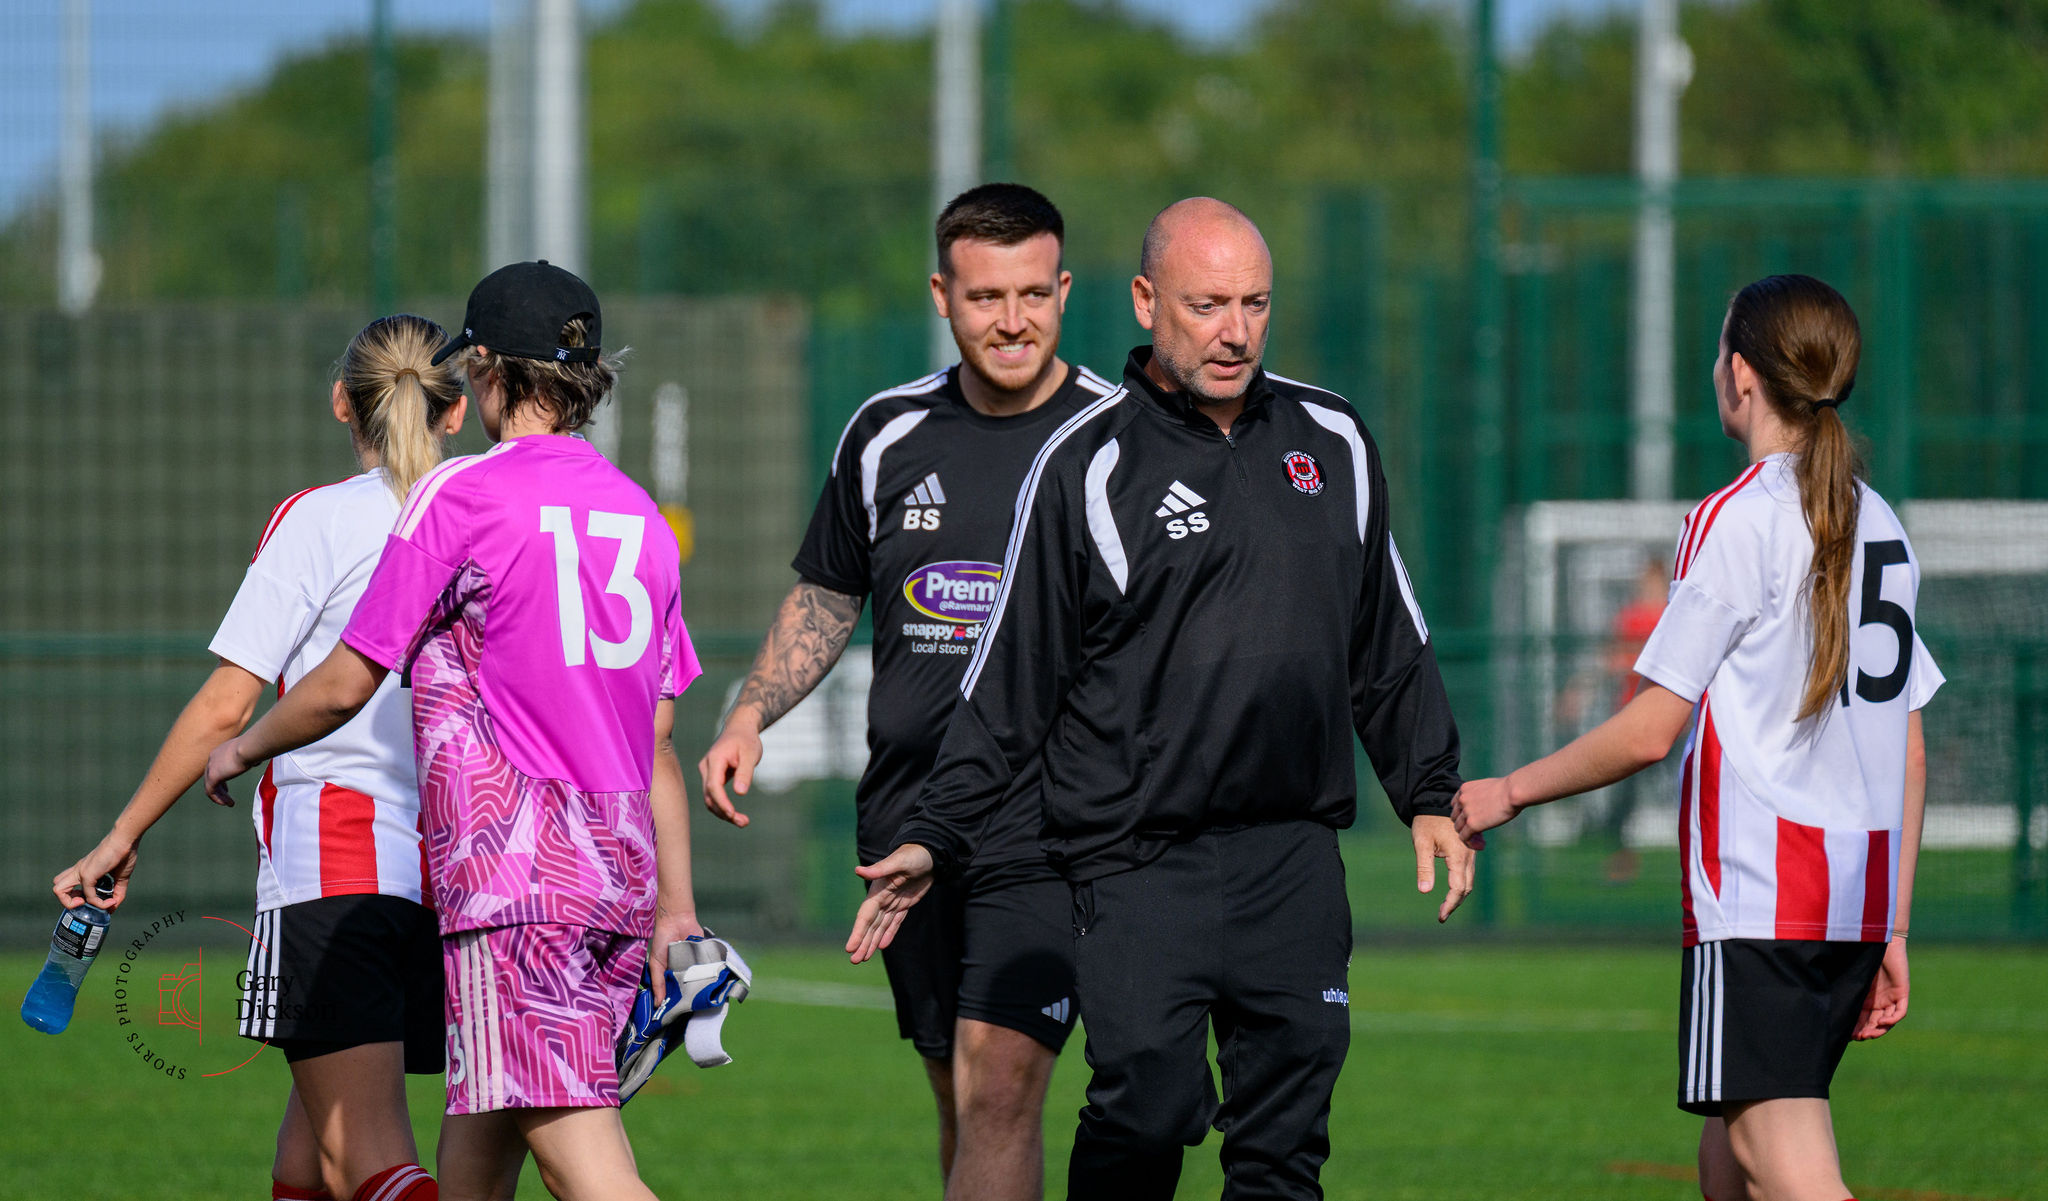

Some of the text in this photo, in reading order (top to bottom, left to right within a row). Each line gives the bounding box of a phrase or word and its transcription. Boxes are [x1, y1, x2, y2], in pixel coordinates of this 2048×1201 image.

[1283, 451, 1315, 463] SUNDERLAND
[1292, 482, 1308, 493] WEST
[902, 508, 940, 531] BS
[1166, 511, 1210, 540] SS
[540, 506, 652, 669] 13
[902, 623, 957, 641] snappy
[1840, 540, 1914, 707] 5
[911, 641, 937, 654] Local
[938, 643, 968, 655] store
